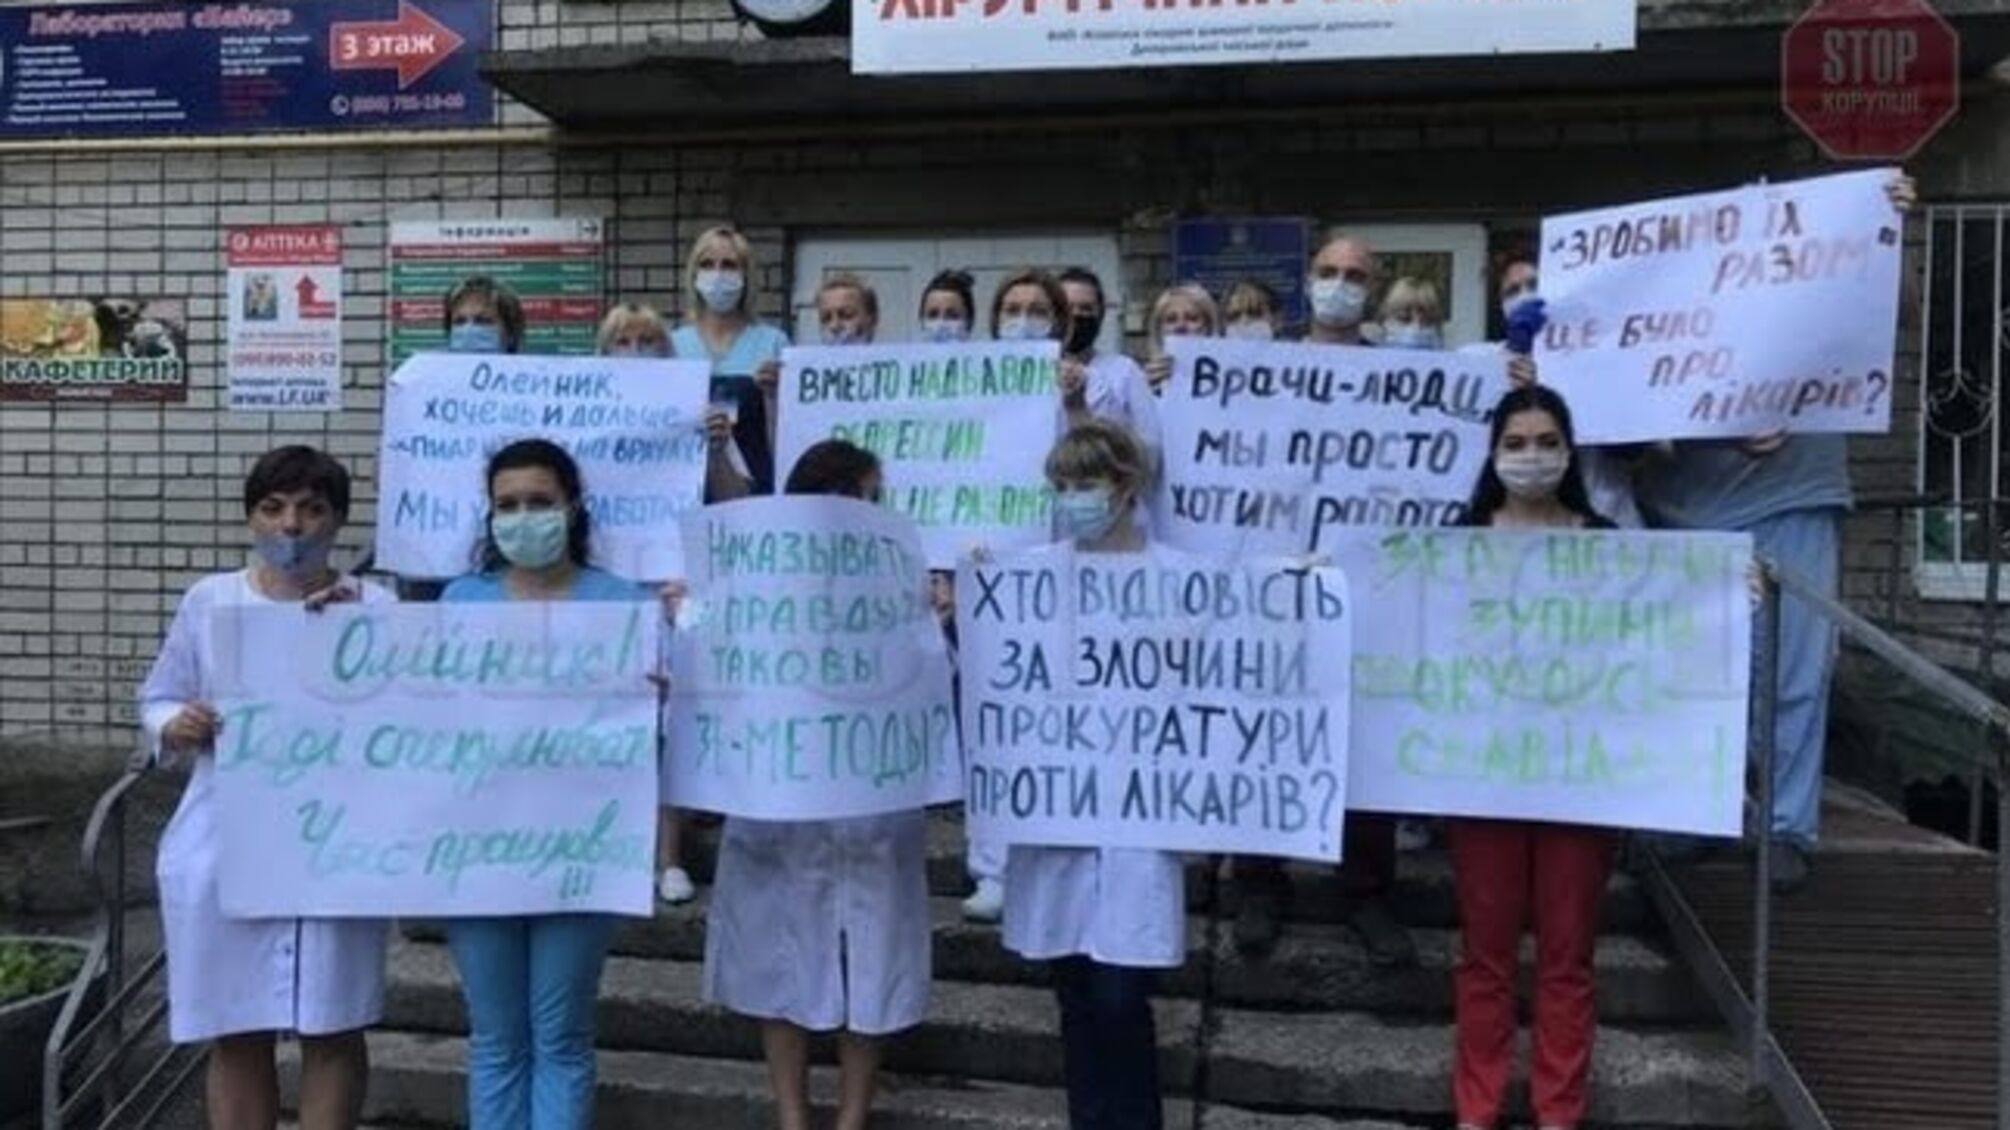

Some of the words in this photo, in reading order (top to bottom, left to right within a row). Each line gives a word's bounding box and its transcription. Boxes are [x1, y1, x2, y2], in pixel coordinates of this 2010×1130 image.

[342, 36, 358, 60] 3
[367, 33, 436, 57] этаж
[252, 231, 320, 250] АПТЕКА
[2, 357, 184, 384] КАФЕТЕРИЙ
[798, 360, 901, 402] ВМЕСТО
[1647, 347, 1734, 388] ПРО
[973, 567, 1057, 623] ХТО
[1078, 568, 1344, 622] ВІДПОВІСТЬ
[710, 648, 882, 687] ТАКОВЫ
[988, 639, 1052, 693] ЗА
[1075, 636, 1310, 695] ЗЛОЧИНИ
[978, 702, 1334, 766] ПРОКУРАТУРИ
[969, 764, 1101, 820] ПРОТИ
